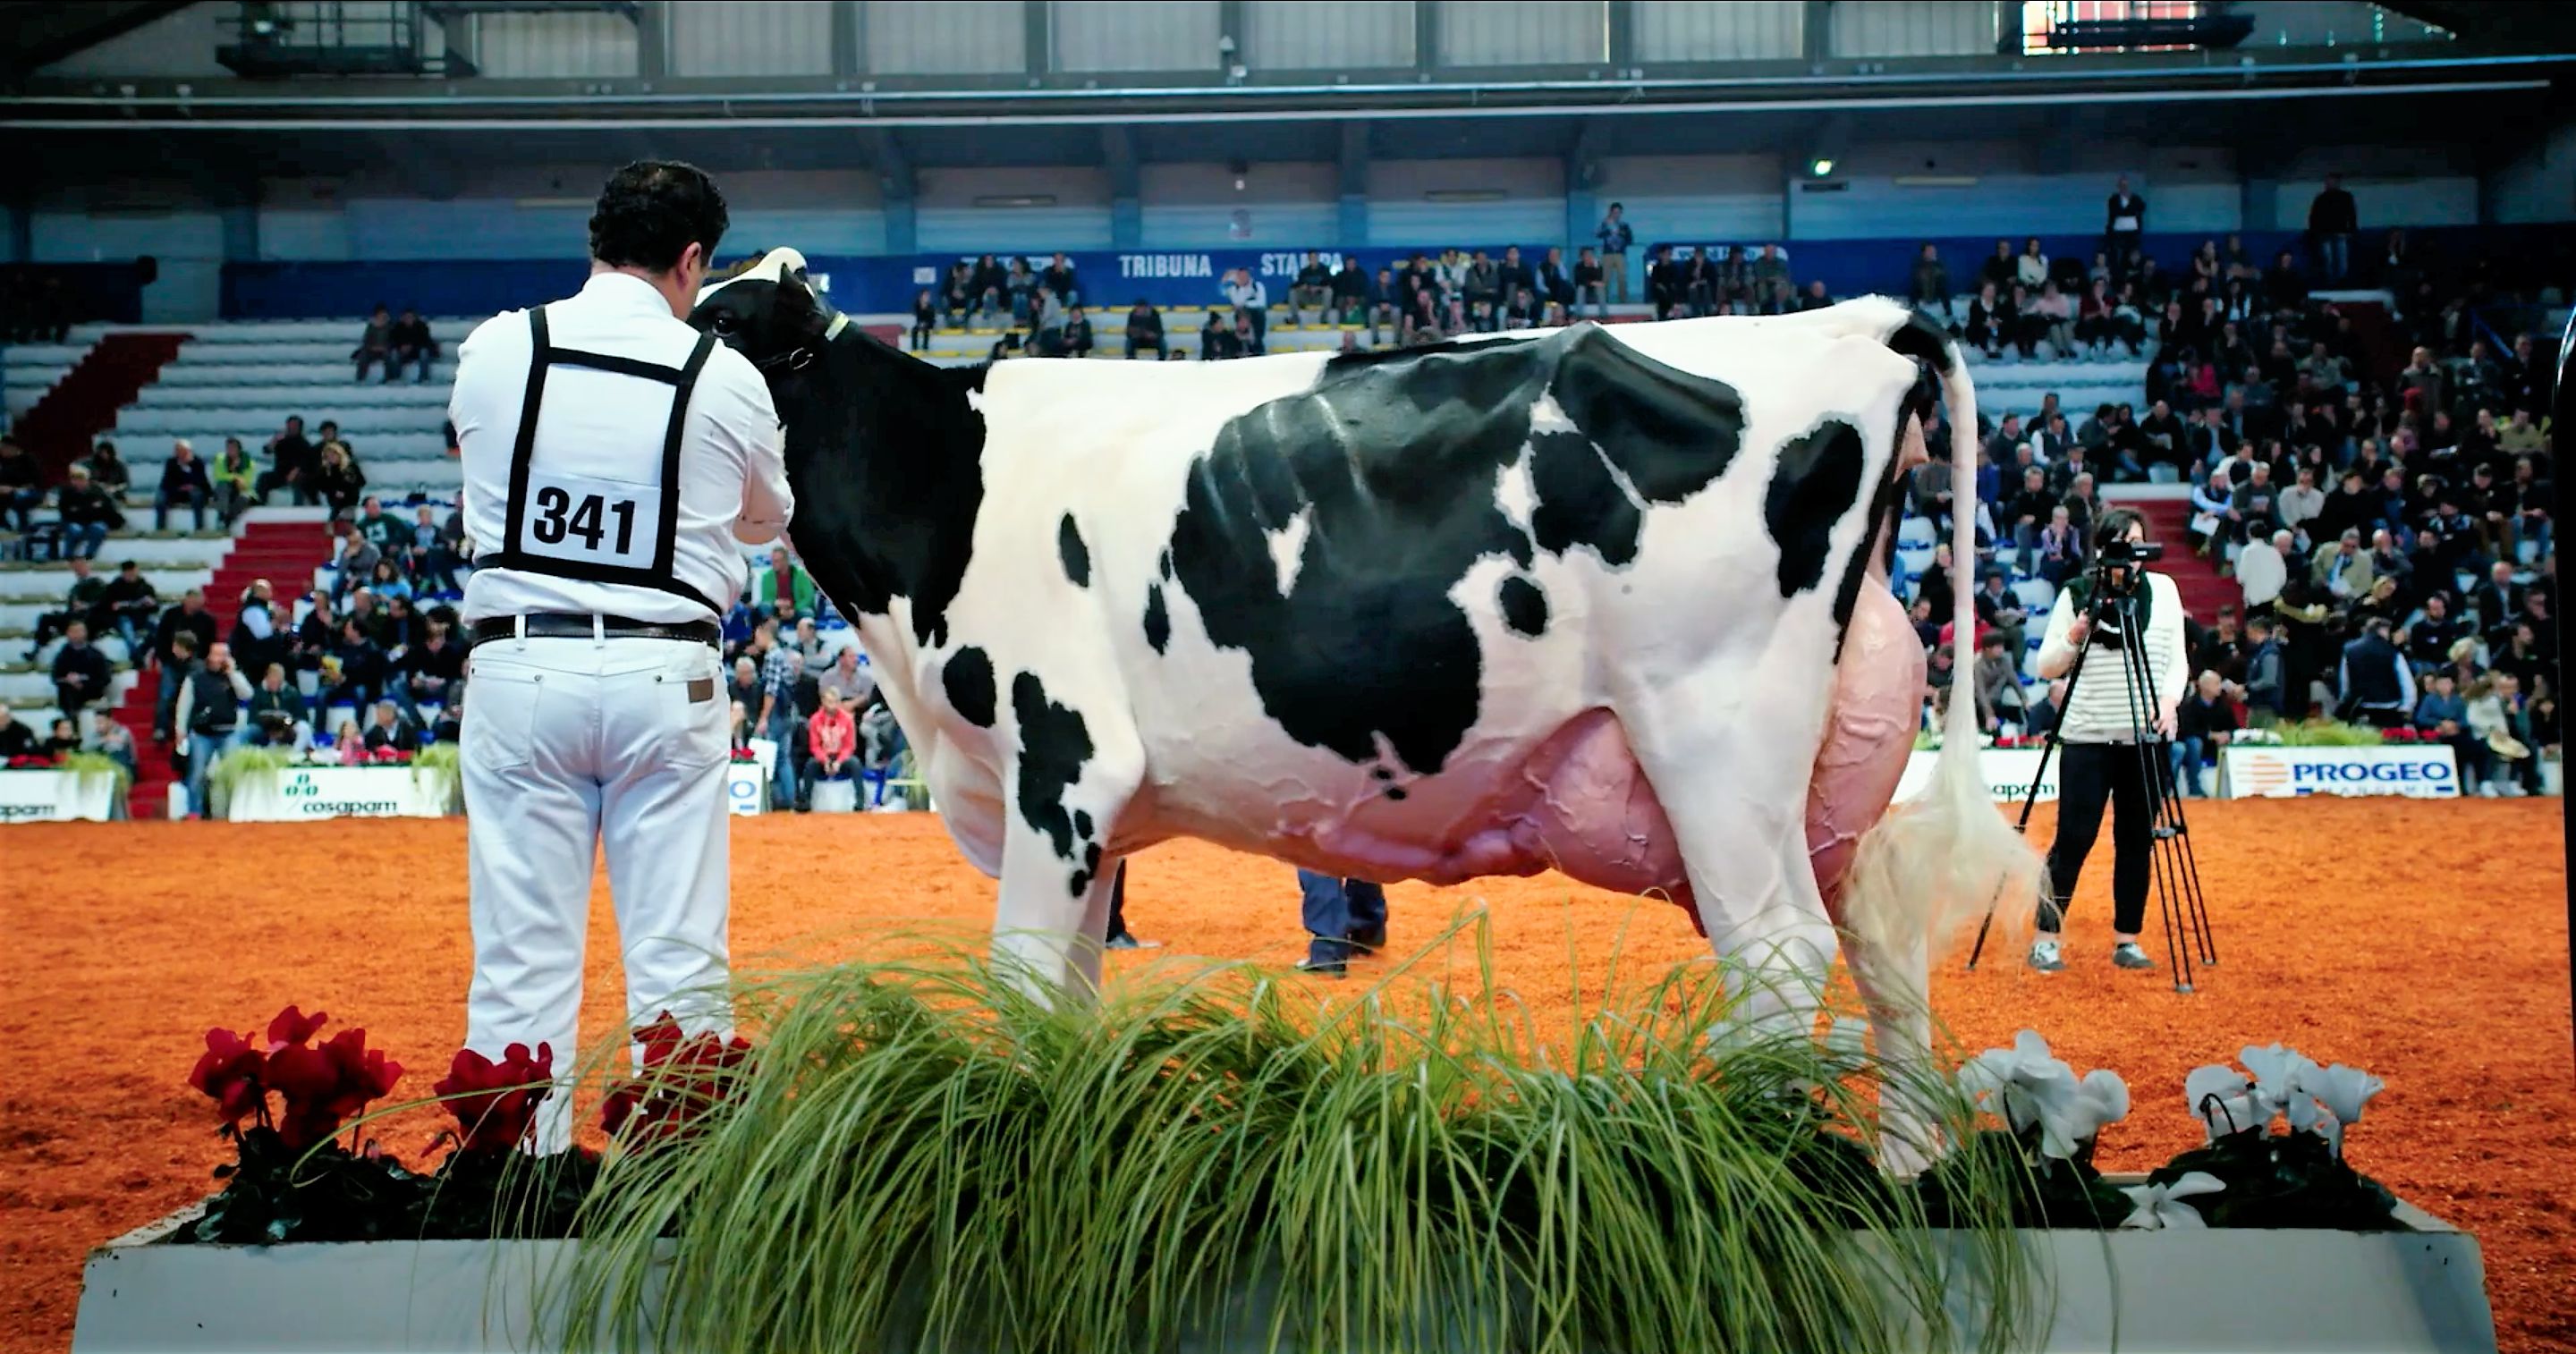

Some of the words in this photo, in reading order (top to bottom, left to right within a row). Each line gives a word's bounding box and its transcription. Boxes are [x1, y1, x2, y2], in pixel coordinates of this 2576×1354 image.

[1119, 255, 1213, 277] TRIBUNA
[534, 487, 635, 554] 341
[2293, 762, 2451, 782] PROGEO
[1992, 783, 2055, 802] apam
[303, 801, 398, 817] cosapam
